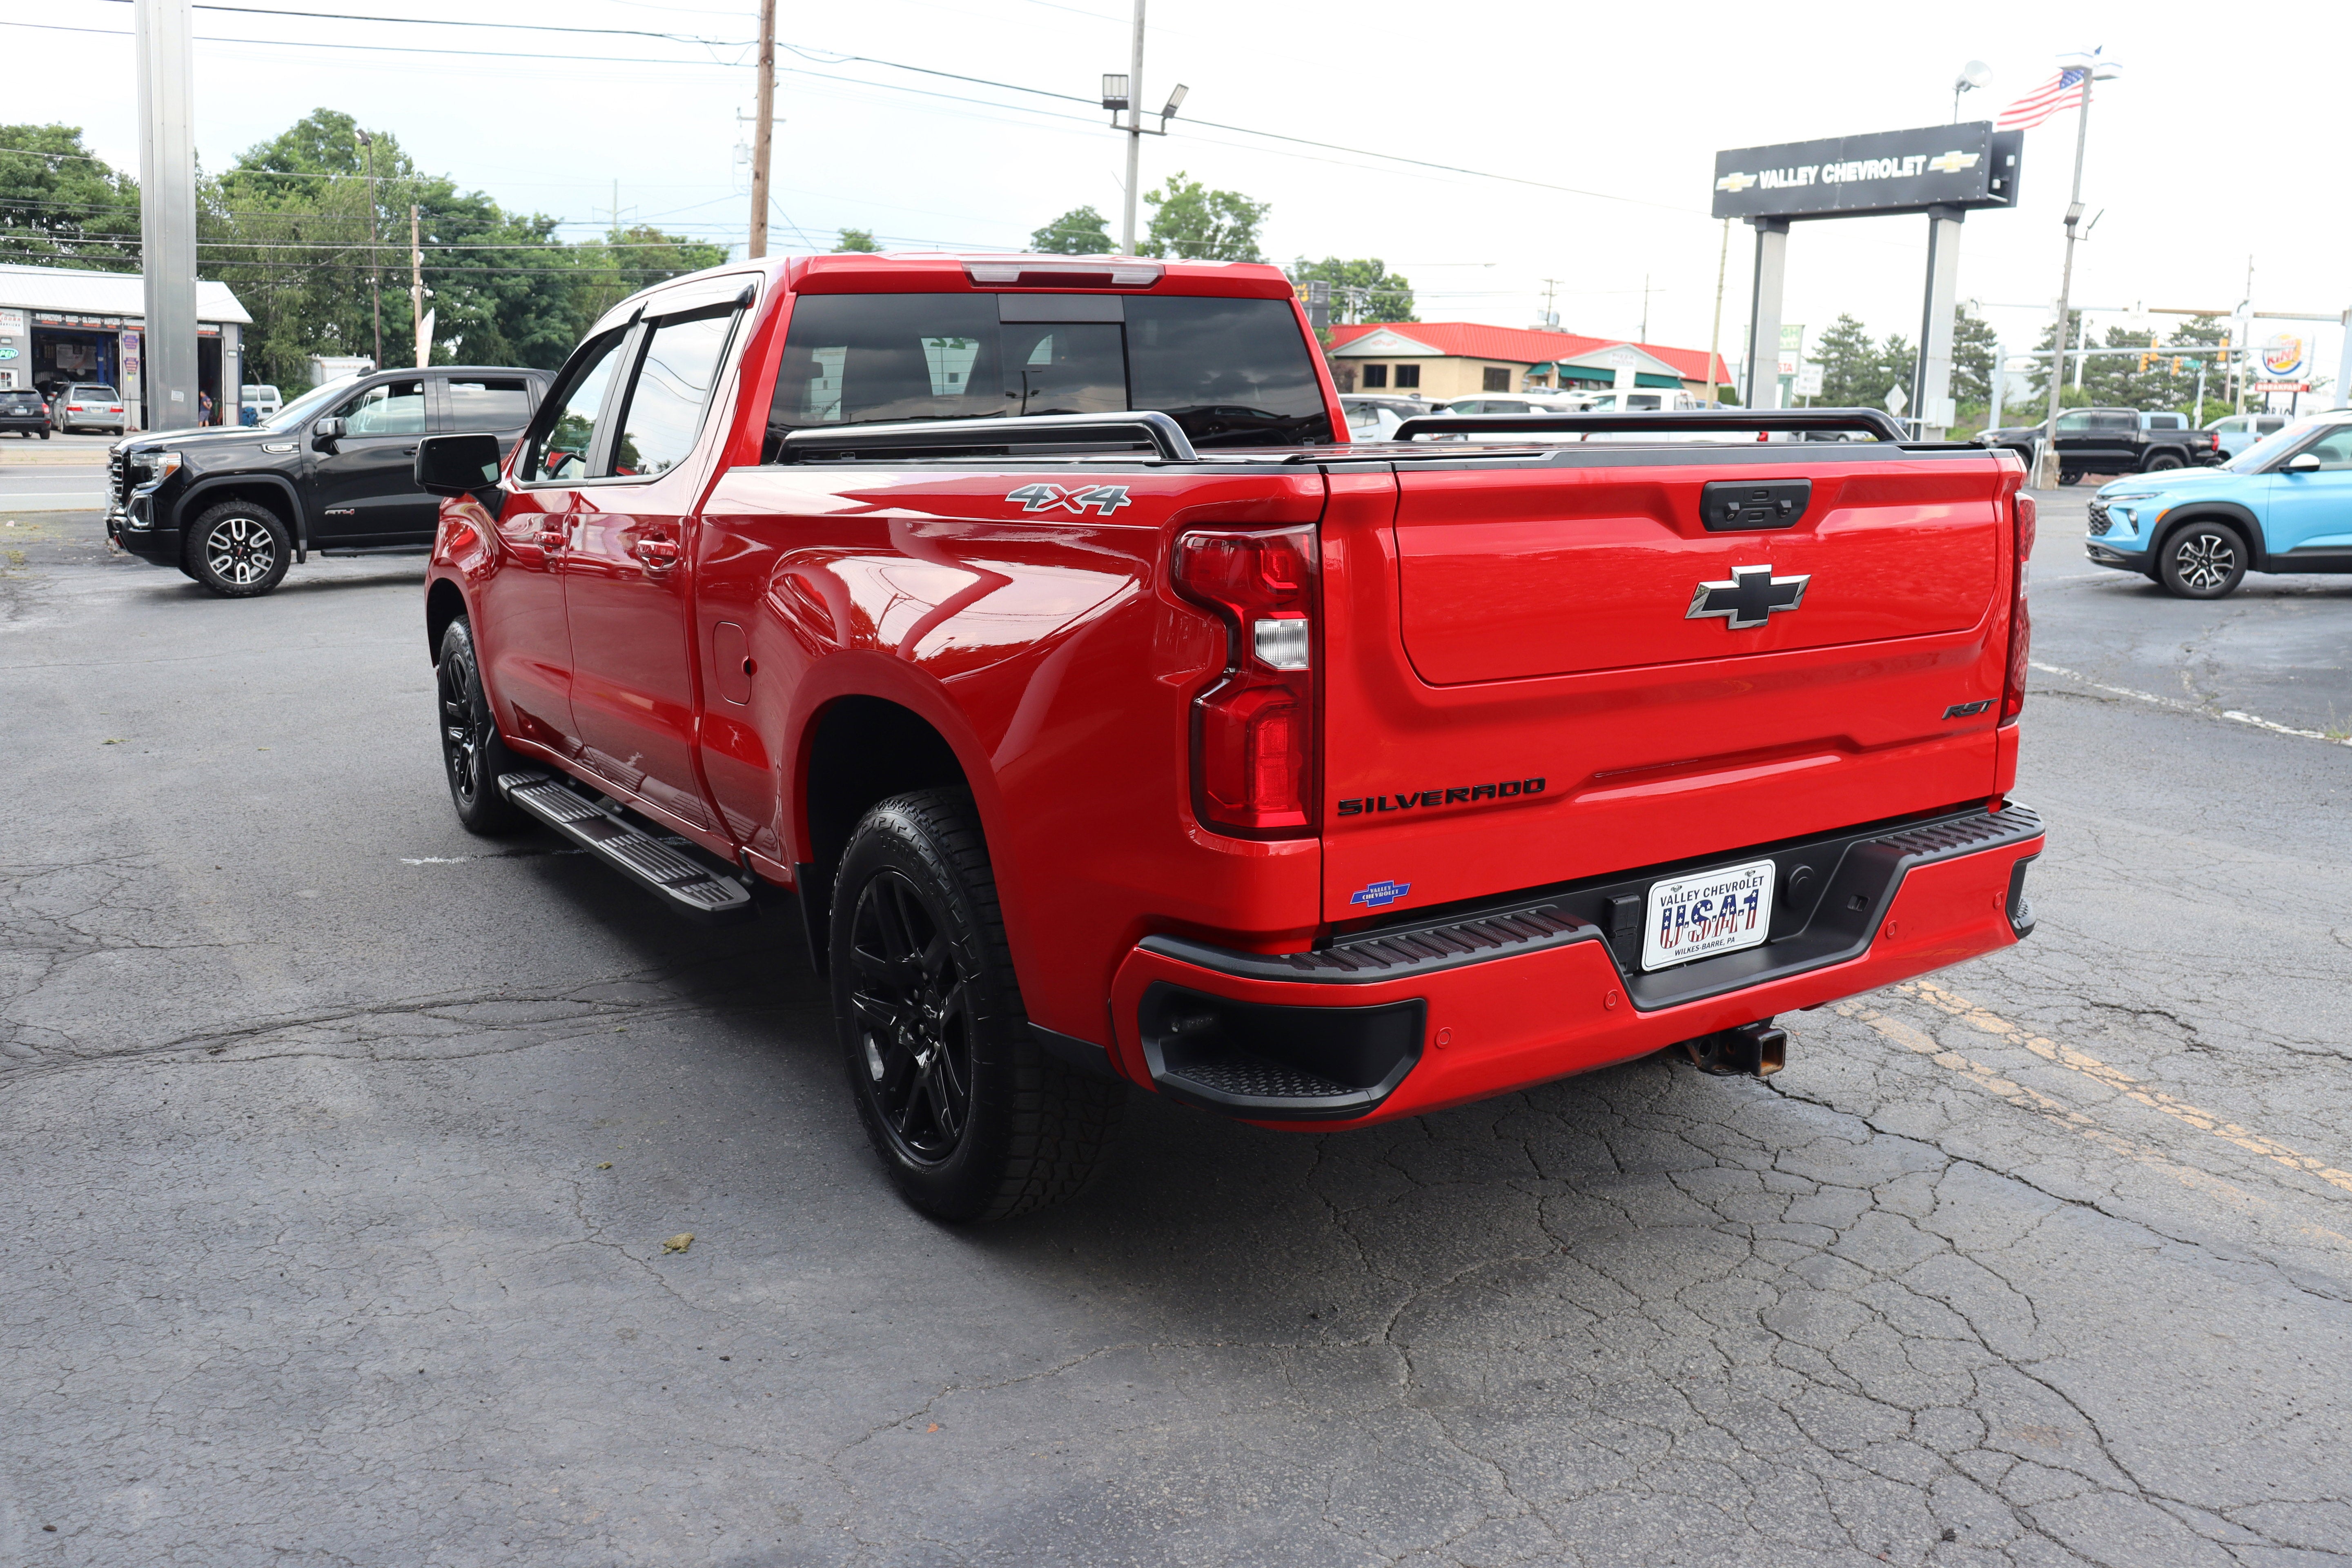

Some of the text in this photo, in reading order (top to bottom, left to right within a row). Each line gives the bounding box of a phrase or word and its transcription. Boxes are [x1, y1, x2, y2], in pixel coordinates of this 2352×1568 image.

[1759, 155, 1927, 189] VALLEY CHEVROLET
[0, 350, 16, 359] PEN
[2257, 383, 2302, 391] BREAKFAST
[1942, 698, 1998, 719] RST
[1337, 777, 1546, 816] SILVERADO
[1362, 885, 1399, 900] VALLEY CHEVROLET
[1660, 875, 1764, 907] VALLEY CHEVROLET
[1675, 939, 1725, 956] WILKES-BARRE,
